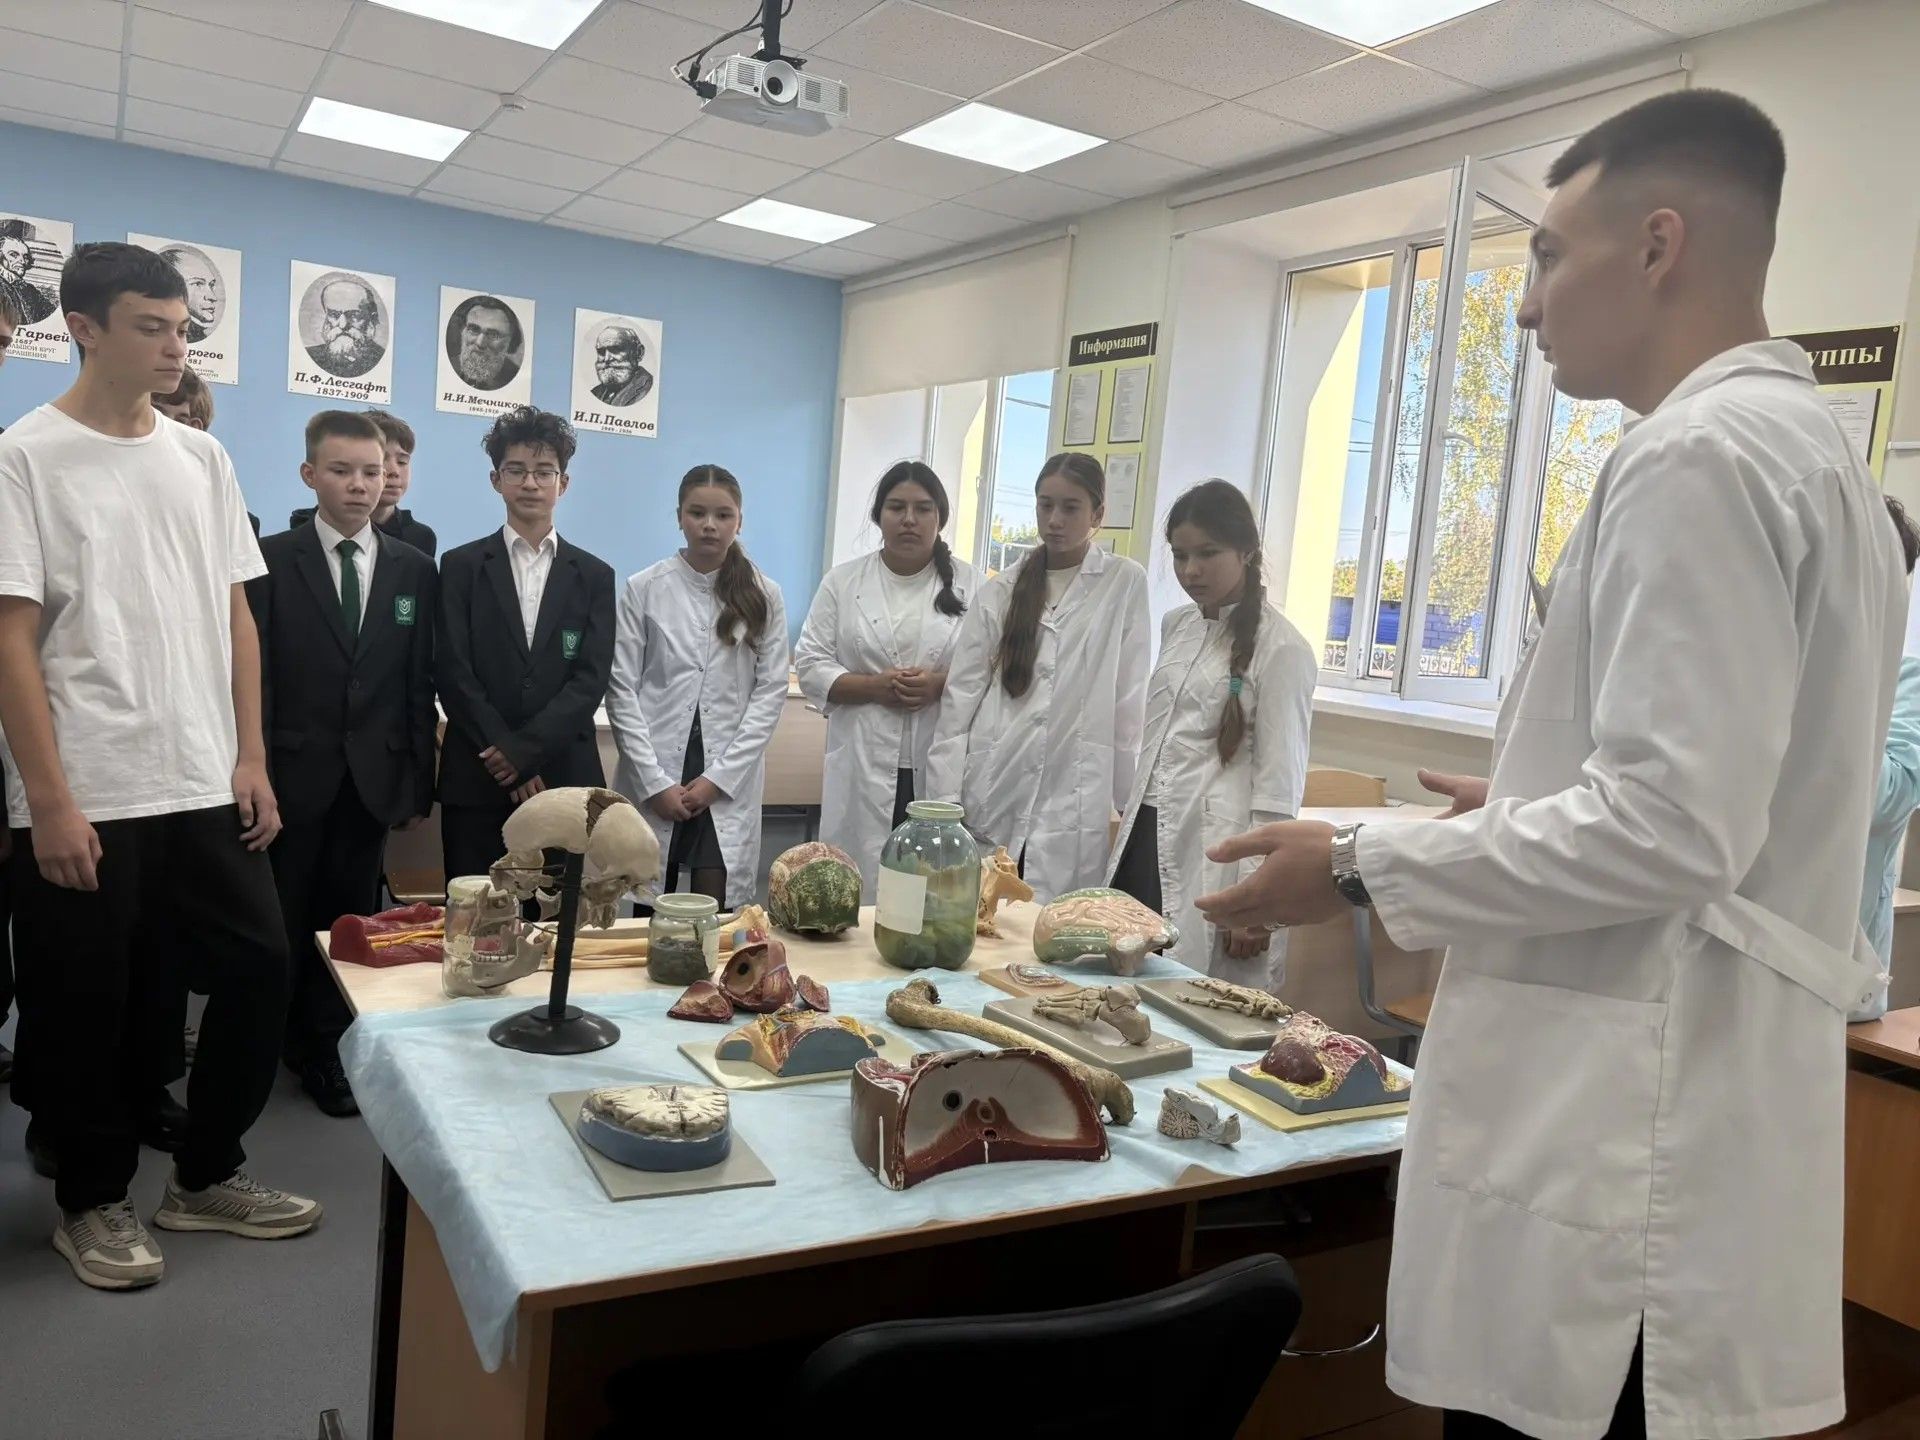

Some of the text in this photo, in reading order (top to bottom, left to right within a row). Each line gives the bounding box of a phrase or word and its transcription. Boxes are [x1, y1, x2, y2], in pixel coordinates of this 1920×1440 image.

[15, 327, 70, 343] Гарвей
[1078, 334, 1147, 356] Информация
[187, 349, 224, 360] рогов
[295, 372, 387, 393] П.Ф.Лесгафт
[316, 387, 369, 400] 1837-1909
[573, 411, 655, 431] И.П.Павлов
